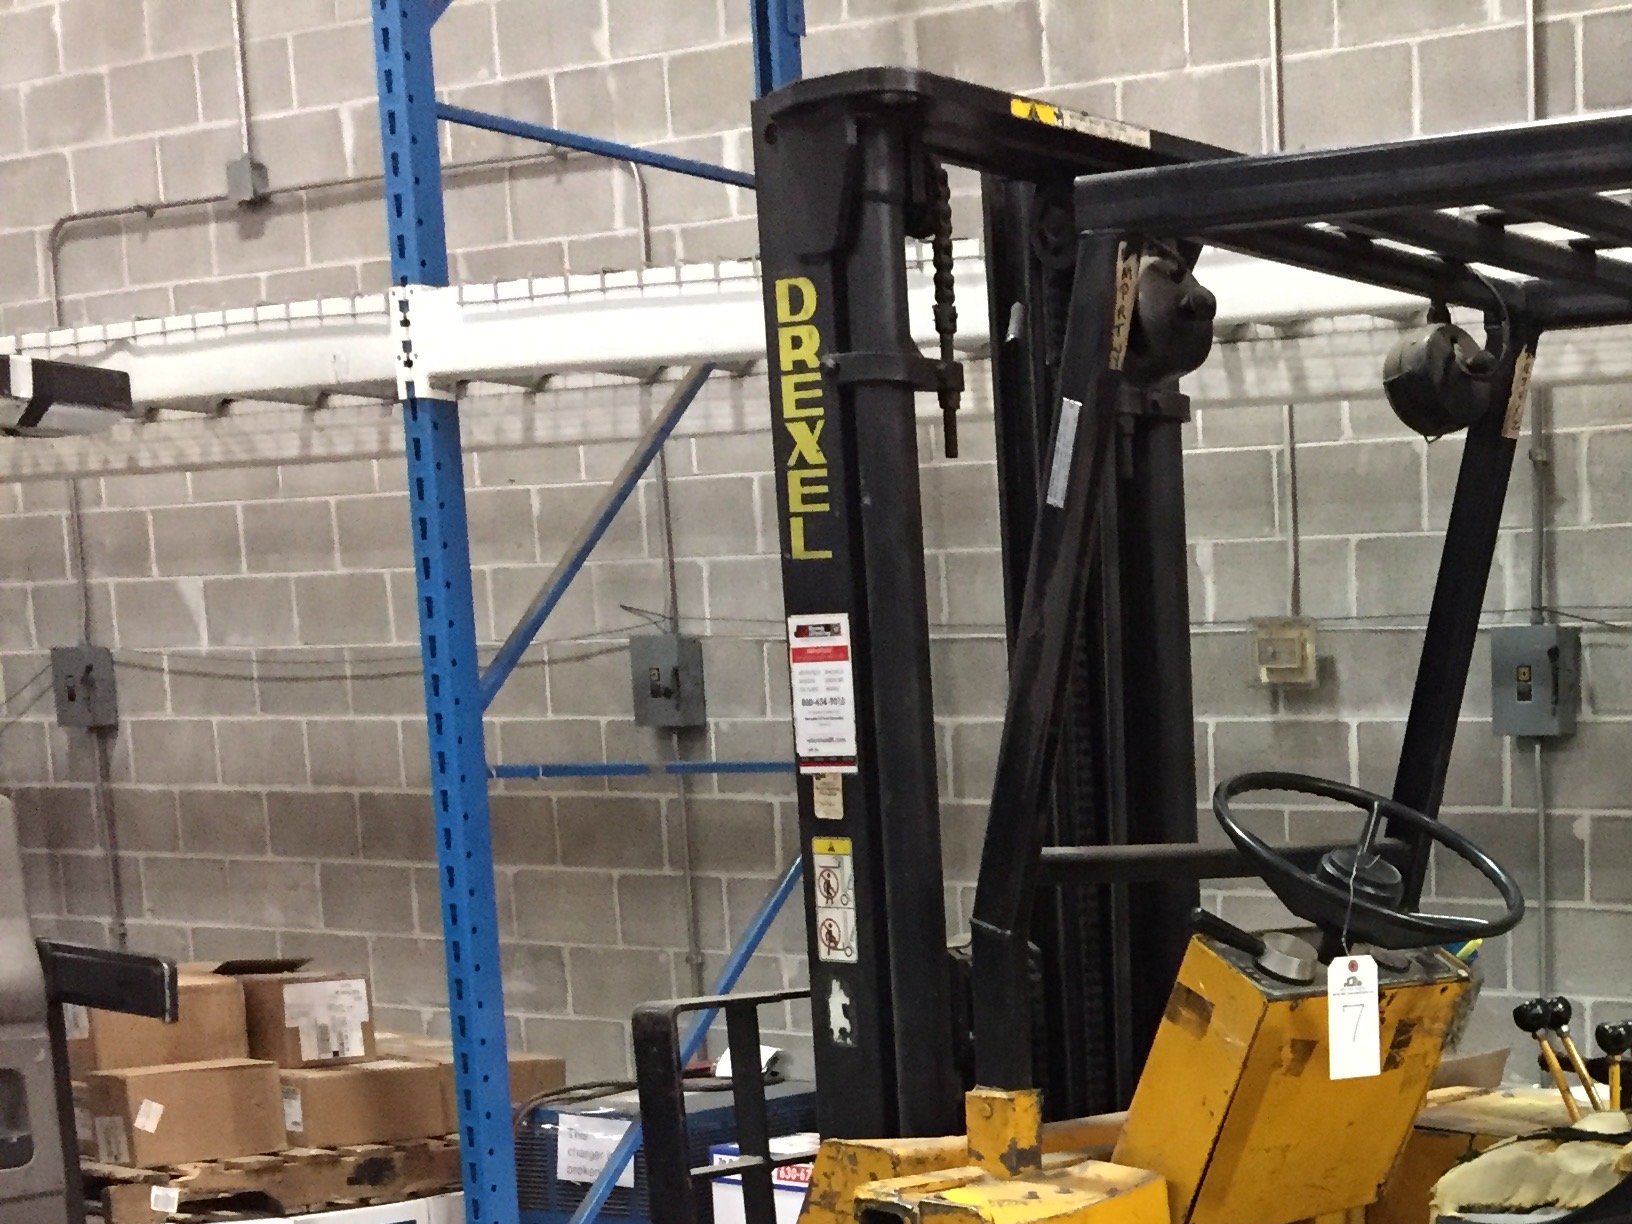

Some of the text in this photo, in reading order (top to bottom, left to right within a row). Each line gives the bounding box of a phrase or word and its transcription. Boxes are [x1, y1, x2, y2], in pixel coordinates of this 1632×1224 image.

[775, 277, 833, 560] DREXEL
[1343, 1003, 1364, 1042] 7
[779, 1165, 811, 1182] 630-67
